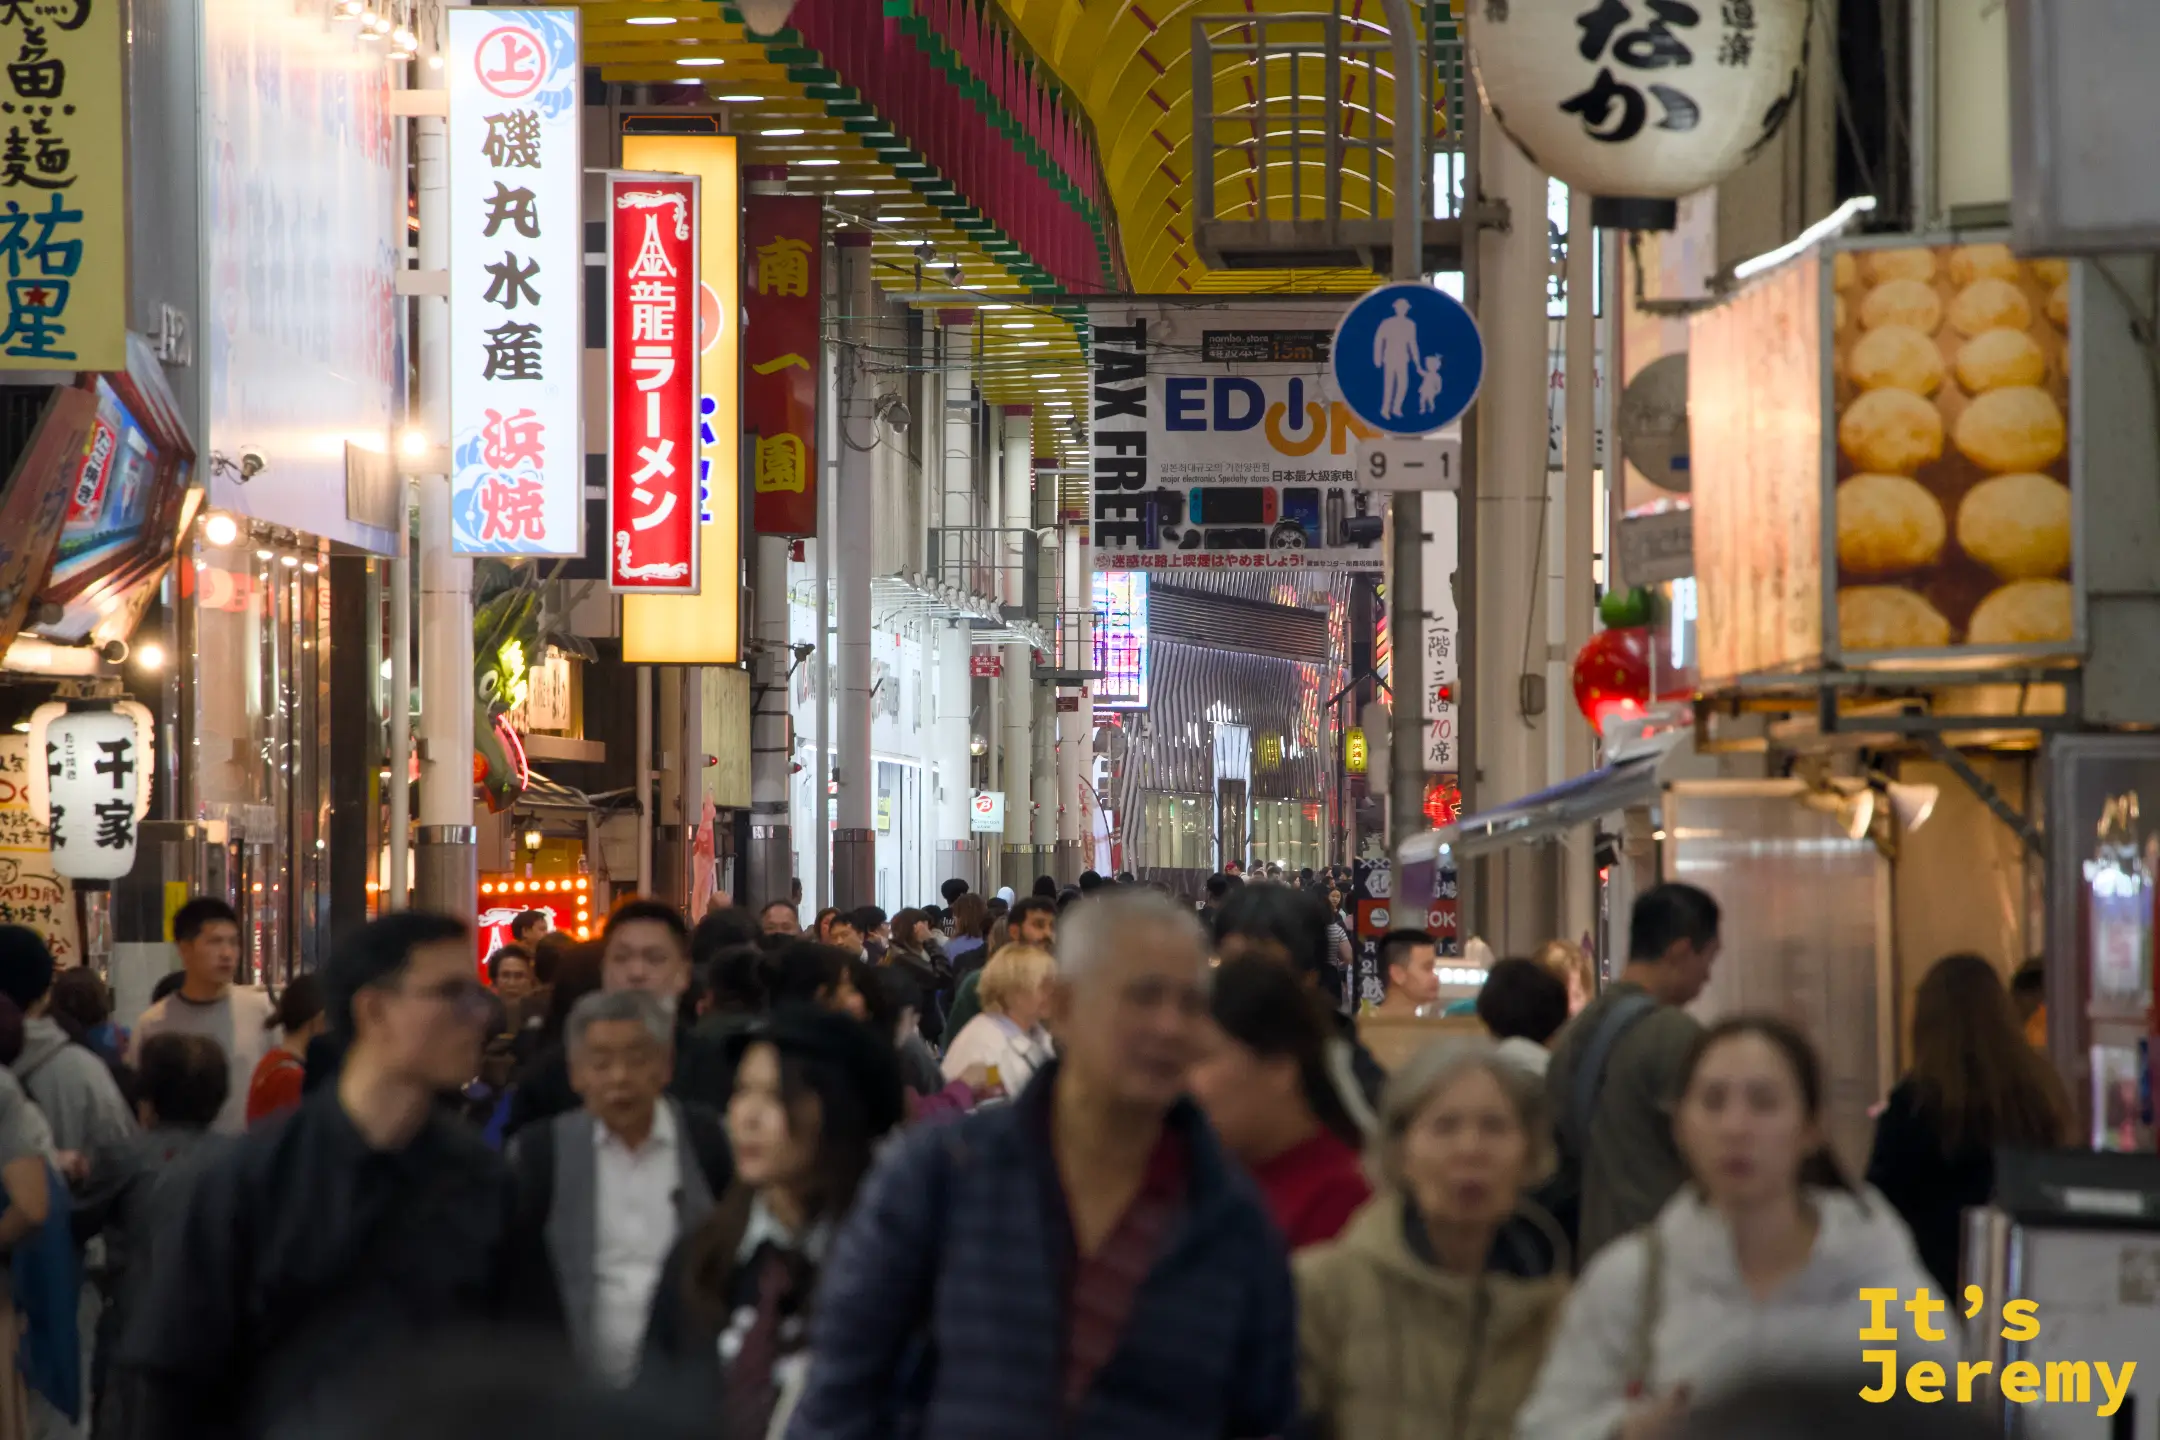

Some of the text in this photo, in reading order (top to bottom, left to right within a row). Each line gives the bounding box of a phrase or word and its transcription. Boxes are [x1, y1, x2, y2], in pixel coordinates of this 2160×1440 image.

[484, 33, 537, 84] 上
[481, 108, 543, 381] 磯丸水産
[628, 213, 677, 531] 金龍ラーメン
[1095, 318, 1147, 421] TAX
[481, 408, 547, 541] 浜焼
[1095, 431, 1147, 550] FREE
[1160, 473, 1270, 485] major electronics Specialty stores
[94, 737, 135, 850] 千家
